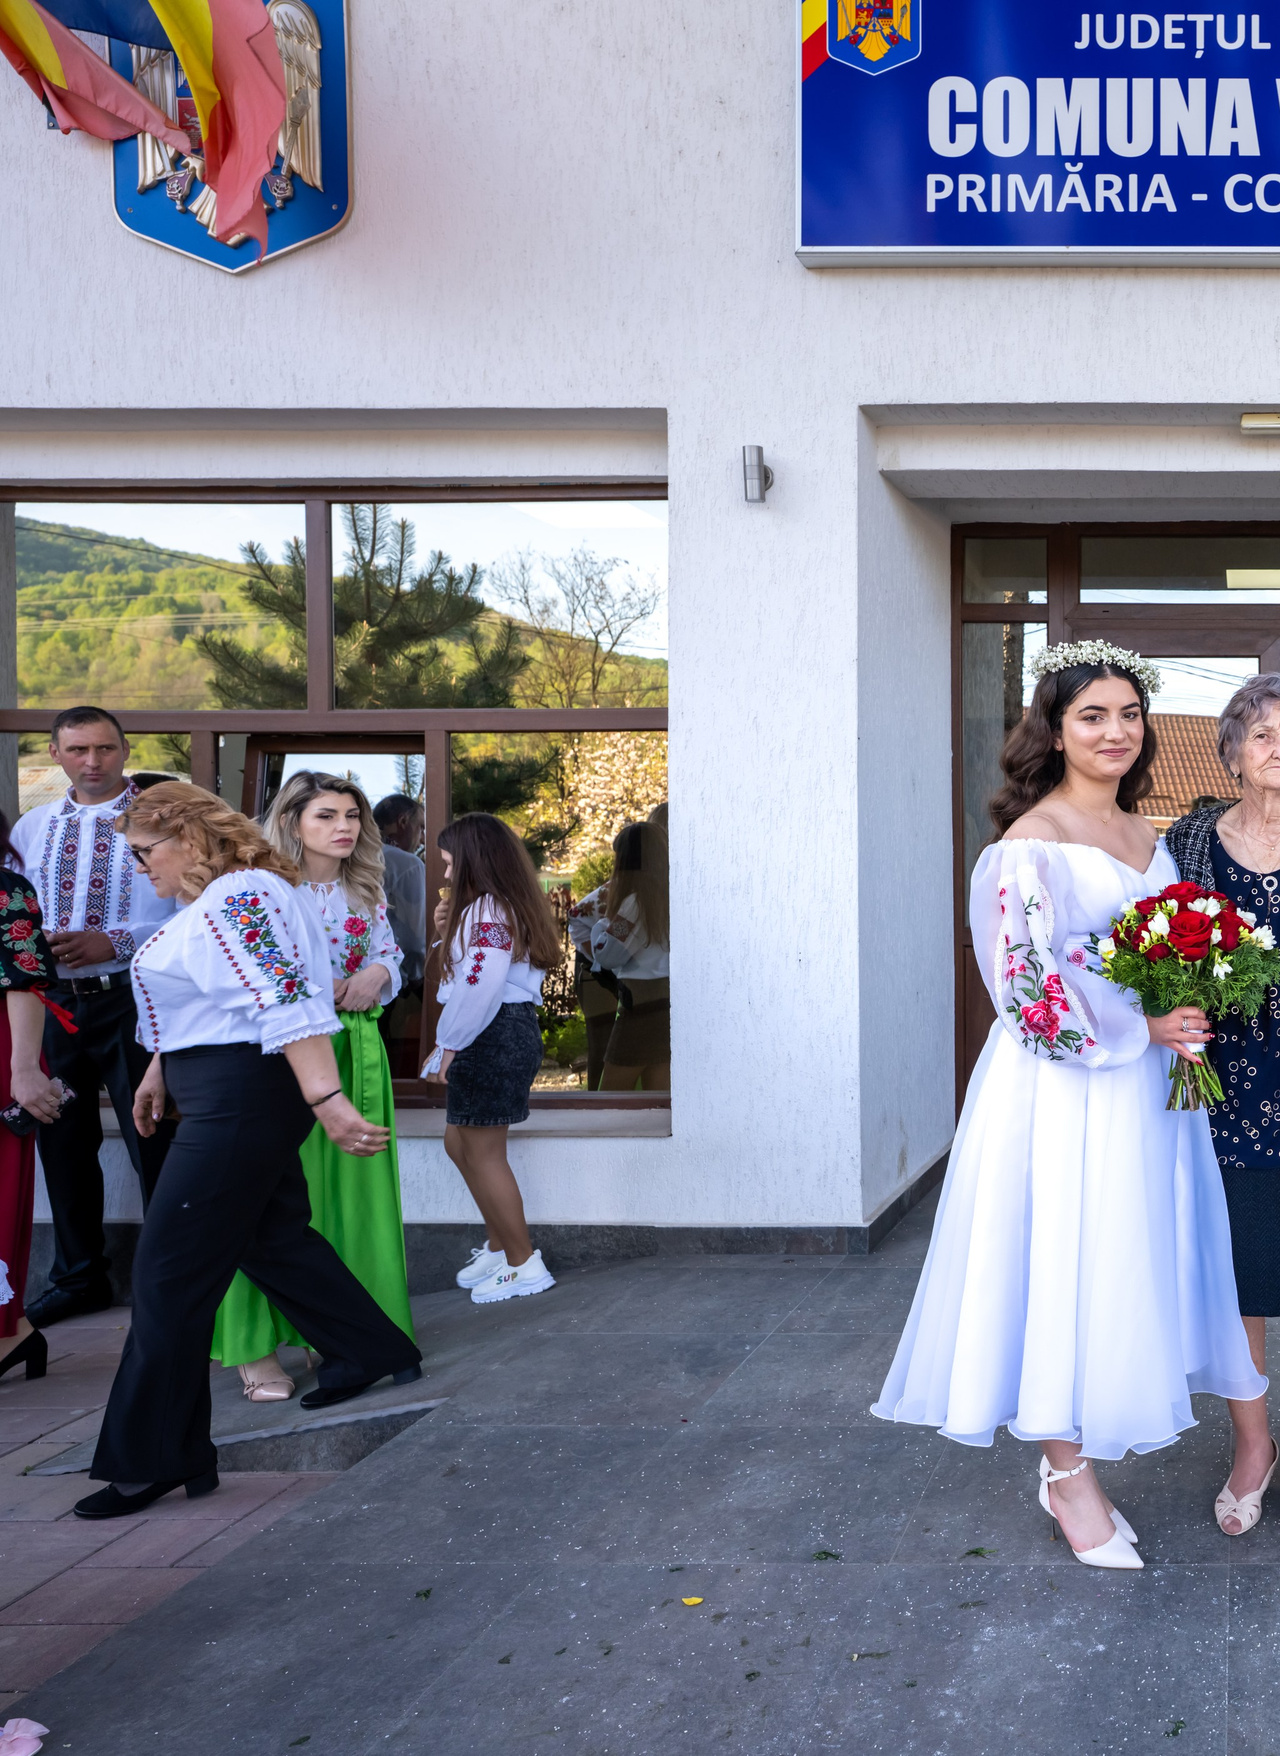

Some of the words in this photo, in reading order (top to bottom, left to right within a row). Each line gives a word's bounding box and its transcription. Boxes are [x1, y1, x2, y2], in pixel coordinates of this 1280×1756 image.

[1074, 13, 1272, 59] JUDEȚUL
[927, 75, 1261, 158] COMUNA
[926, 162, 1178, 213] PRIMĂRIA
[1191, 193, 1208, 201] -
[496, 1271, 518, 1285] SUP
